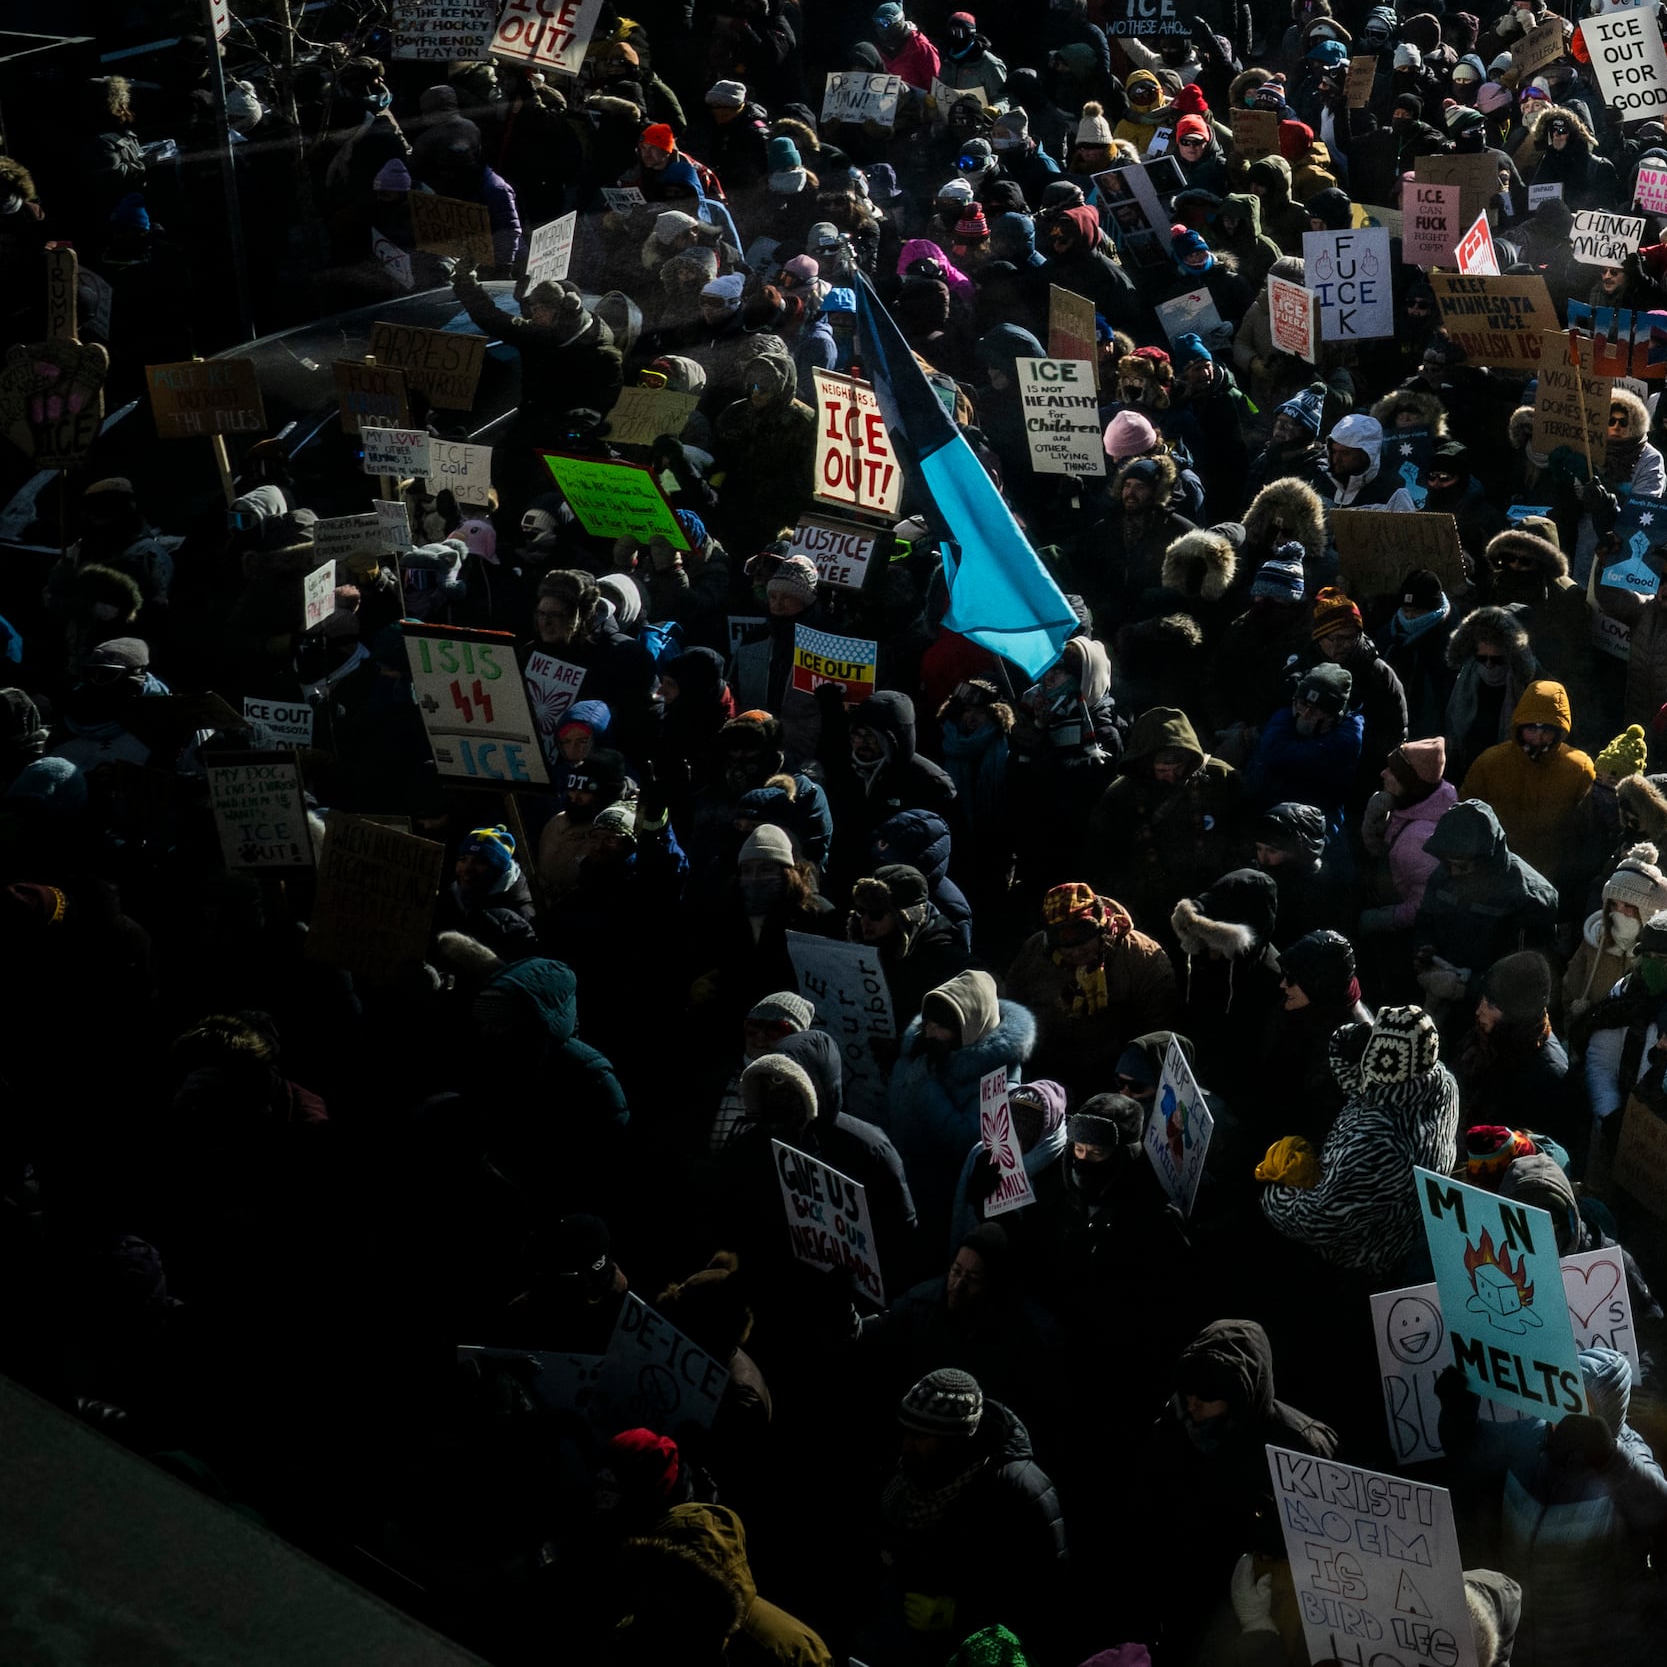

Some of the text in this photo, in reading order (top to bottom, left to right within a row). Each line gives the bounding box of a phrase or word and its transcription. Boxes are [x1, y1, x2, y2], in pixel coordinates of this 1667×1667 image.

[432, 19, 490, 32] HOCKEY
[498, 15, 576, 60] OUT!
[1597, 17, 1642, 43] ICE
[395, 35, 485, 48] BOYFRIENDS
[417, 47, 479, 59] PLAY ON
[1603, 40, 1647, 64] OUT
[1612, 62, 1657, 86] FOR
[1417, 188, 1445, 204] I.C.E.
[1420, 204, 1442, 215] CAN
[1416, 216, 1447, 231] FUCK
[1575, 210, 1646, 243] CHINGA
[1413, 231, 1449, 241] RIGHT
[1419, 241, 1444, 252] OFF!
[1595, 232, 1614, 243] LA
[1574, 239, 1630, 261] MIGRA
[375, 326, 485, 370] ARREST
[1031, 361, 1078, 382] ICE
[1027, 385, 1065, 394] IS NOT
[1025, 395, 1098, 409] HEALTHY
[1048, 408, 1067, 420] for
[825, 401, 888, 457] ICE
[1027, 417, 1100, 434] Children
[1034, 444, 1068, 454] OTHER
[1053, 434, 1071, 444] and
[1051, 452, 1089, 461] LIVING
[1064, 462, 1098, 472] THINGS
[823, 447, 895, 505] OUT!
[797, 524, 869, 561] JUSTICE
[815, 552, 838, 565] FOR
[1607, 570, 1655, 589] for Good
[417, 637, 504, 681] ISIS
[798, 648, 867, 682] ICE OUT
[245, 701, 311, 725] ICE OUT
[460, 738, 531, 782] ICE
[980, 1074, 1008, 1100] WE ARE
[778, 1146, 861, 1222] GIVE US
[985, 1169, 1031, 1208] FAMILY
[791, 1195, 869, 1254] BACK OUR
[1425, 1177, 1537, 1258] M N
[788, 1219, 883, 1299] NEIGHBORS
[622, 1295, 730, 1384] DE-ICE
[1448, 1330, 1585, 1416] MELTS
[1273, 1448, 1435, 1530] KRISTI
[1284, 1494, 1433, 1569] NOEM
[1304, 1542, 1433, 1618] IS A
[1300, 1588, 1459, 1666] BIRD LEG
